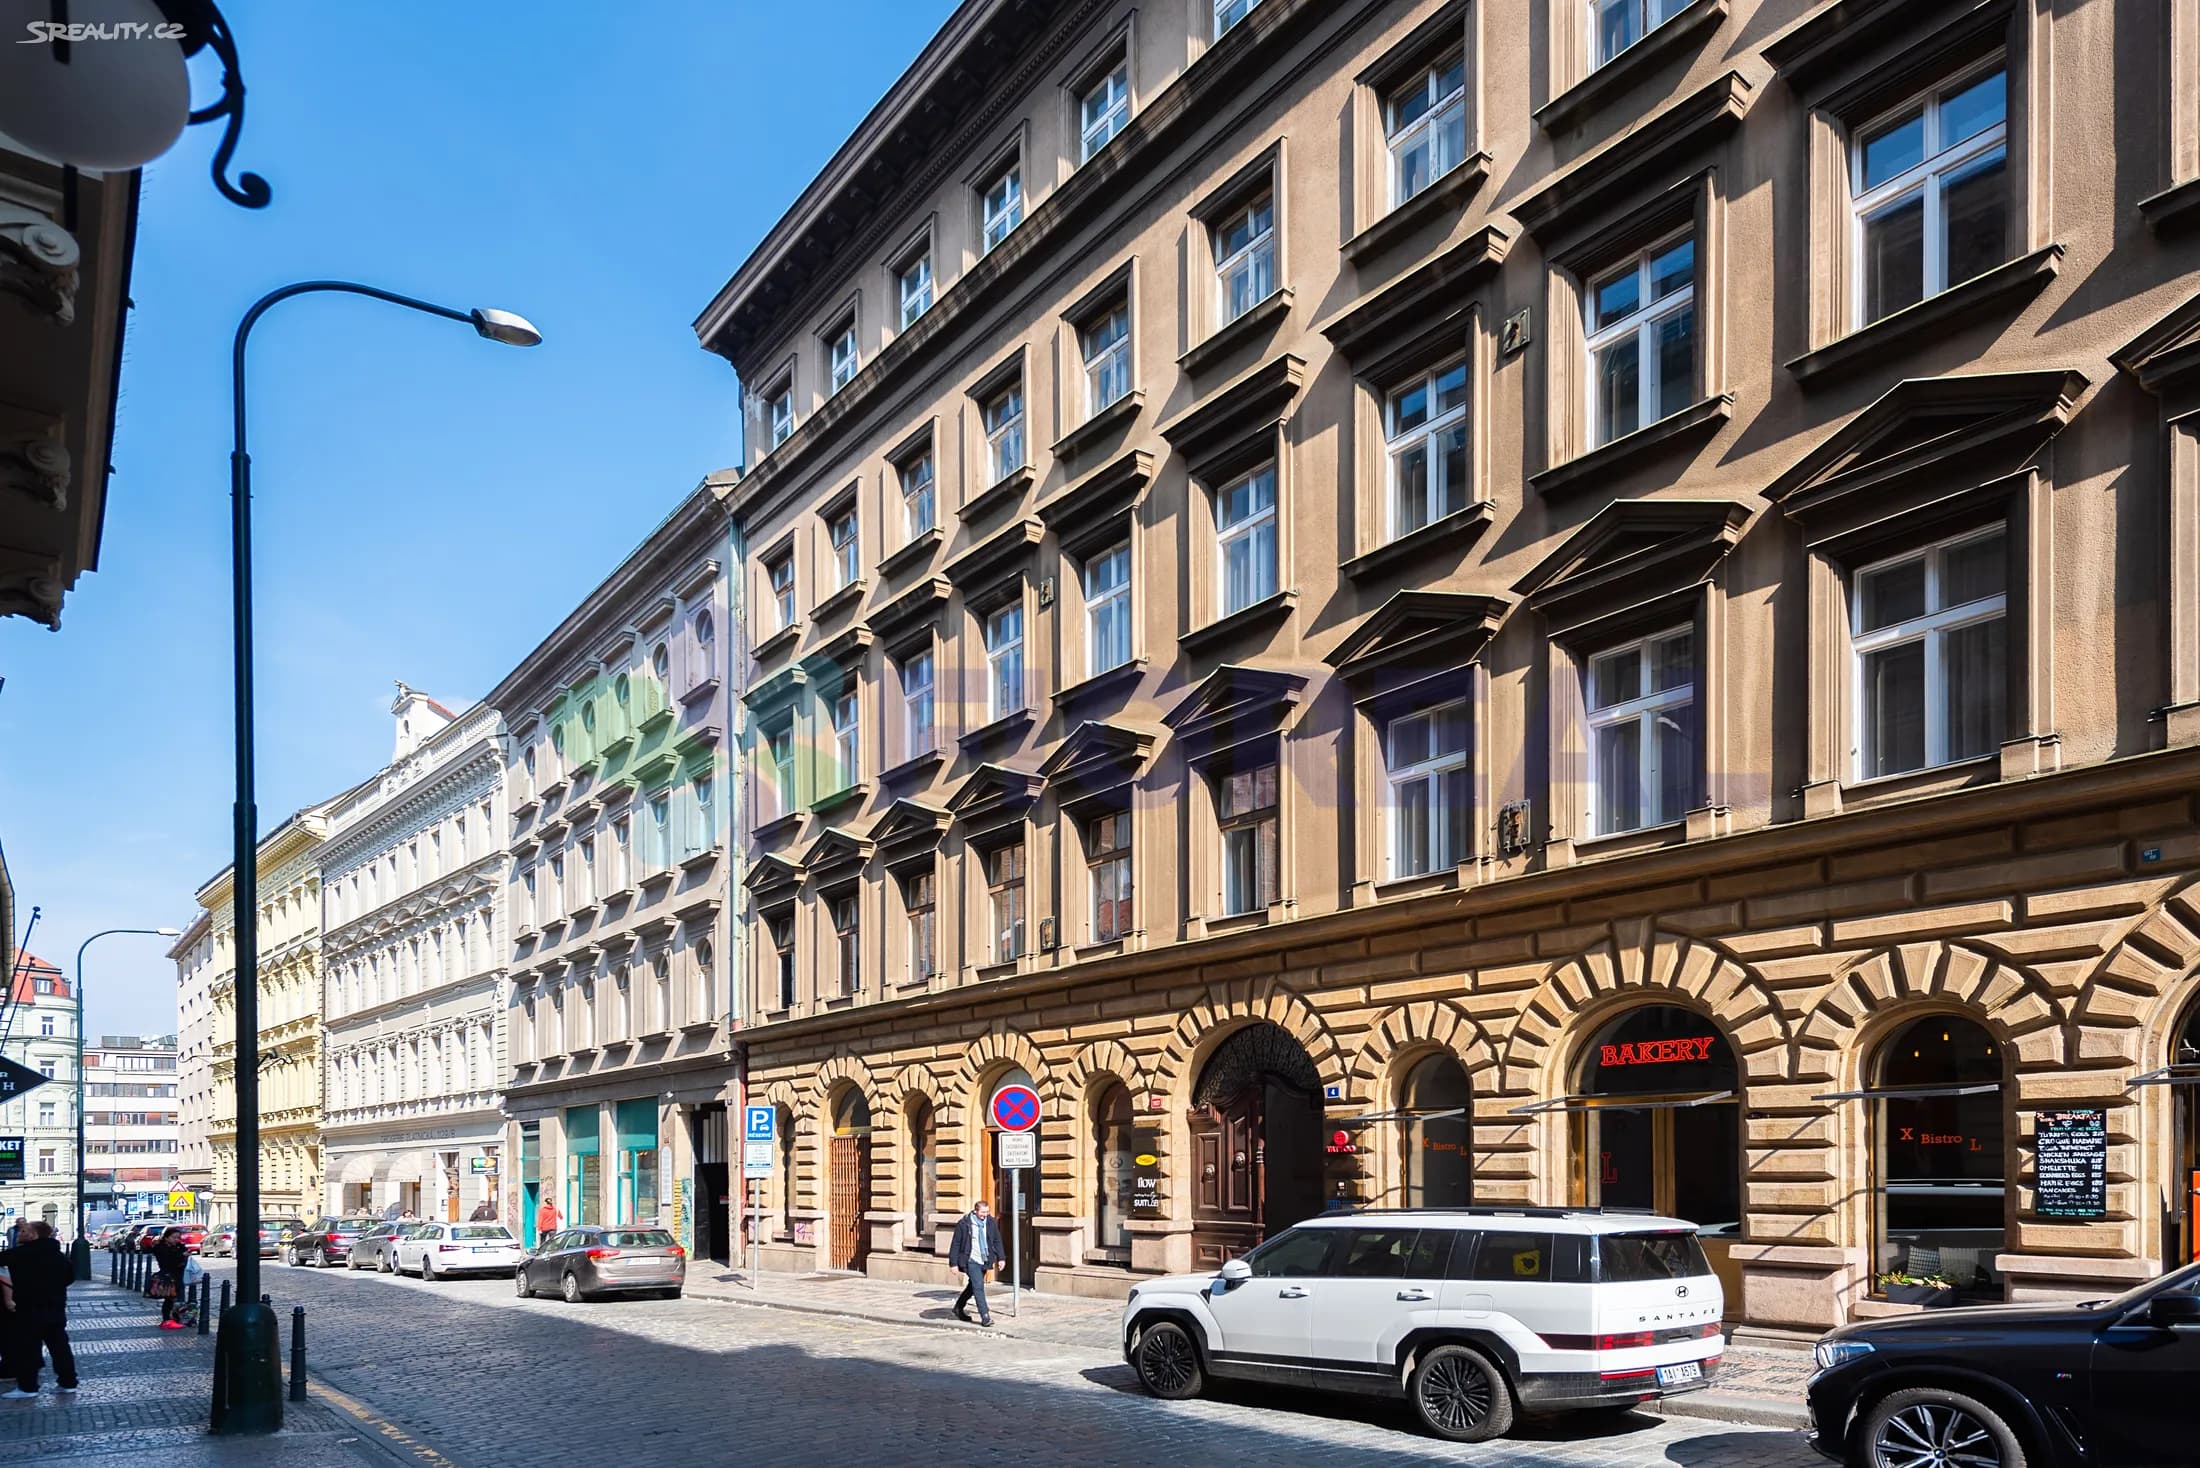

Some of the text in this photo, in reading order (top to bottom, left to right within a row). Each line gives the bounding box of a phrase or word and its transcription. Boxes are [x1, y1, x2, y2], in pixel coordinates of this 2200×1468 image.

[1601, 1037, 1715, 1066] BAKERY
[752, 1110, 769, 1131] P
[1921, 1133, 1962, 1144] Bistro
[1639, 1311, 1695, 1322] SANTA
